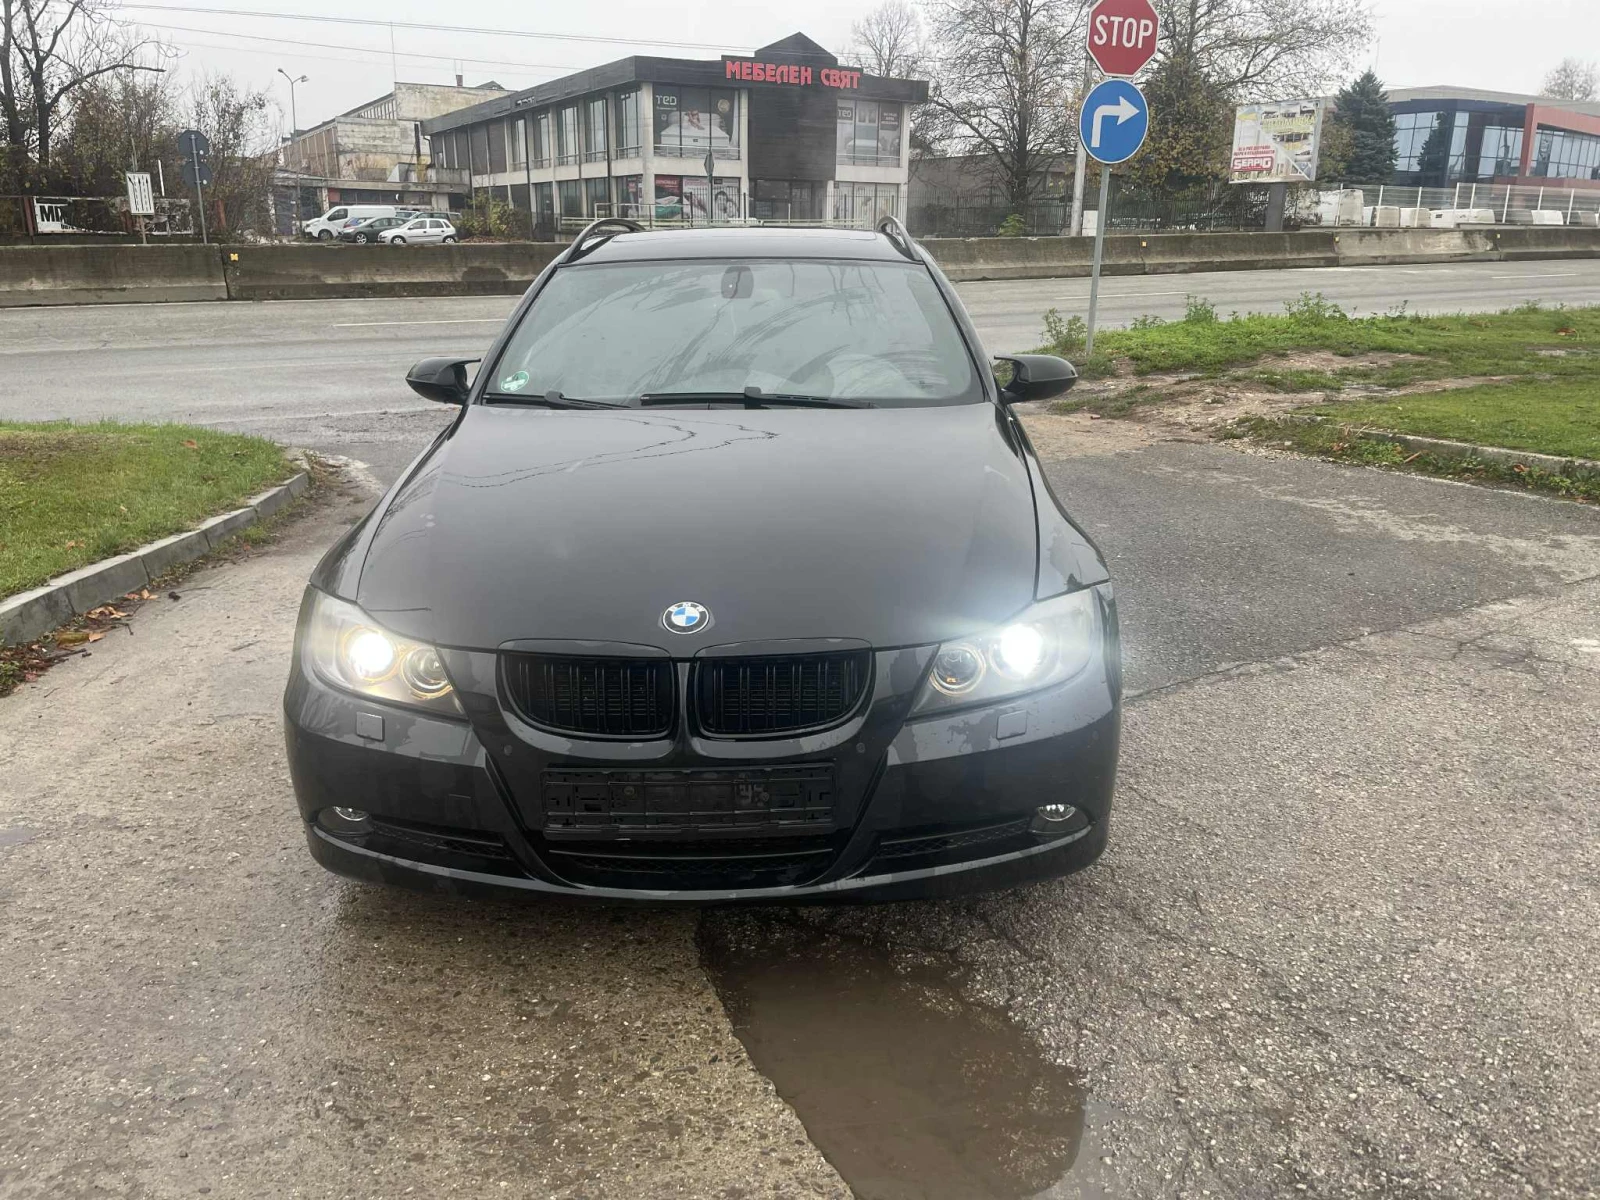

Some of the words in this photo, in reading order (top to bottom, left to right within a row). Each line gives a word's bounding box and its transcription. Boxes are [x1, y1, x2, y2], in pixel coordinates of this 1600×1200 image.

[1093, 14, 1154, 49] STOP
[725, 60, 812, 86] МЕБЕЛЕН
[820, 68, 861, 90] СВЯТ
